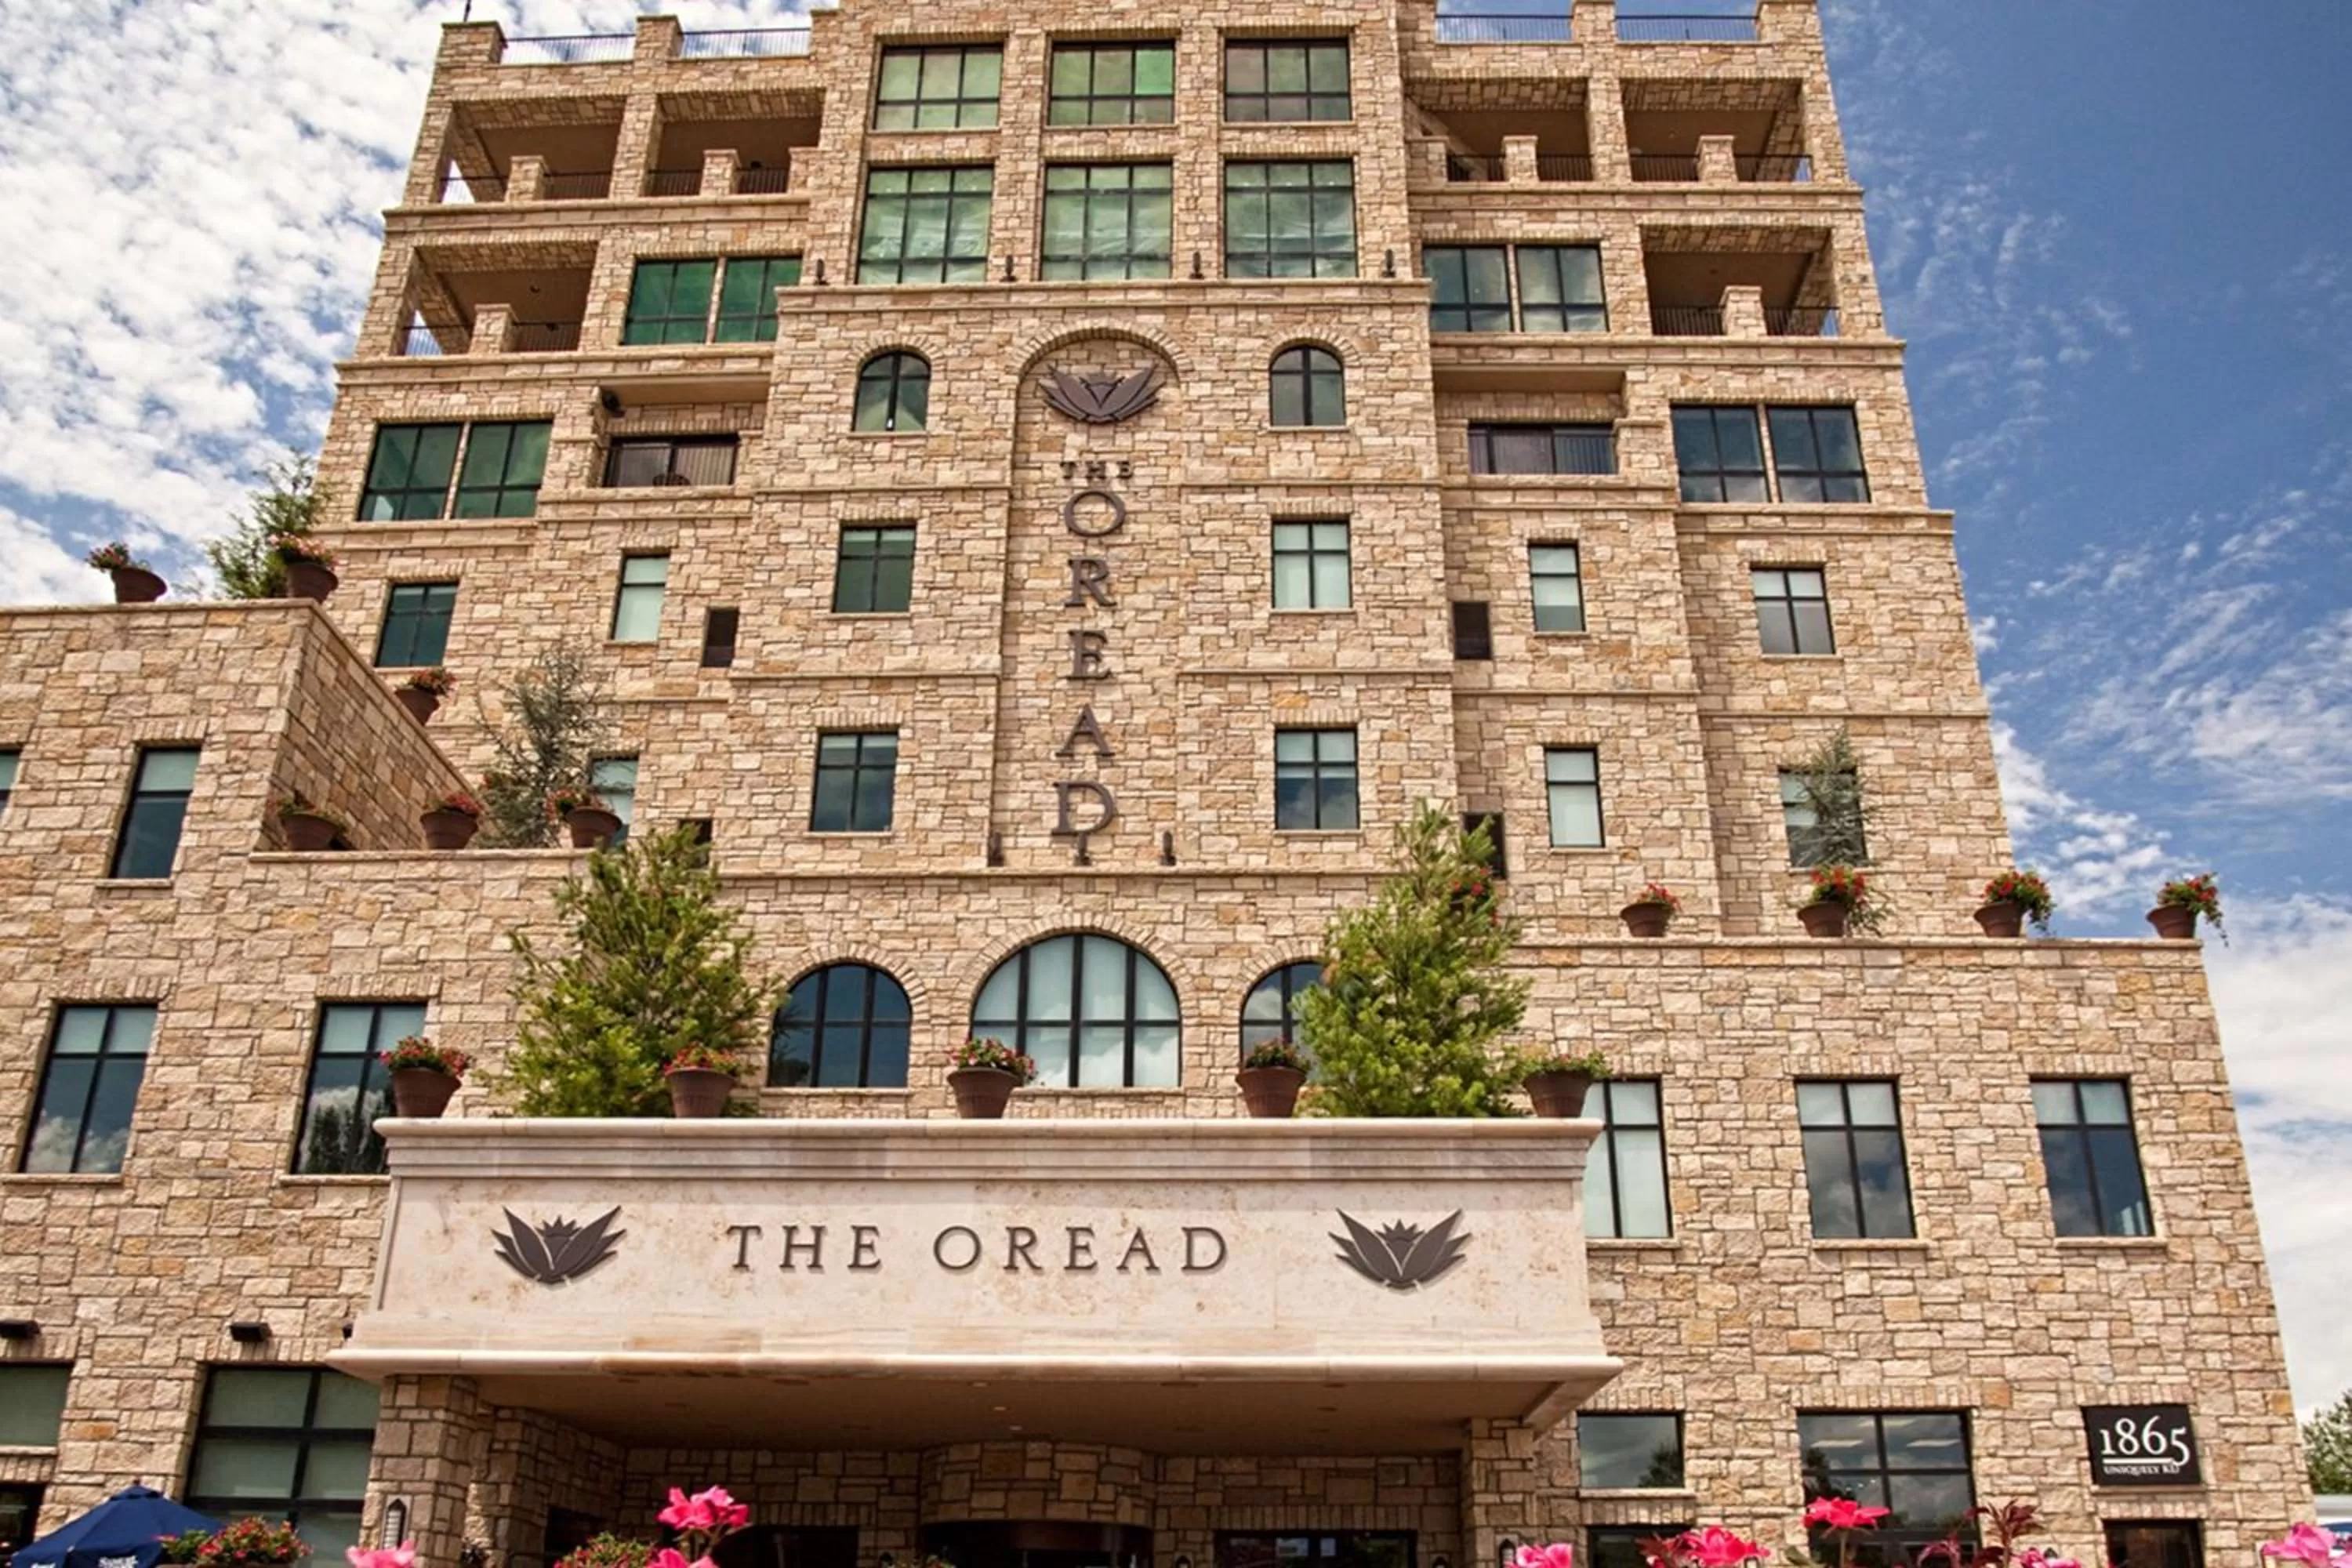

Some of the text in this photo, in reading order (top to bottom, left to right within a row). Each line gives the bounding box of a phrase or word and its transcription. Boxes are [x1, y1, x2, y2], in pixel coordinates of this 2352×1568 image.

[1060, 461, 1133, 479] THE
[1051, 490, 1127, 837] OREAD
[727, 1225, 1227, 1271] THE OREAD
[2100, 1415, 2190, 1466] 1865
